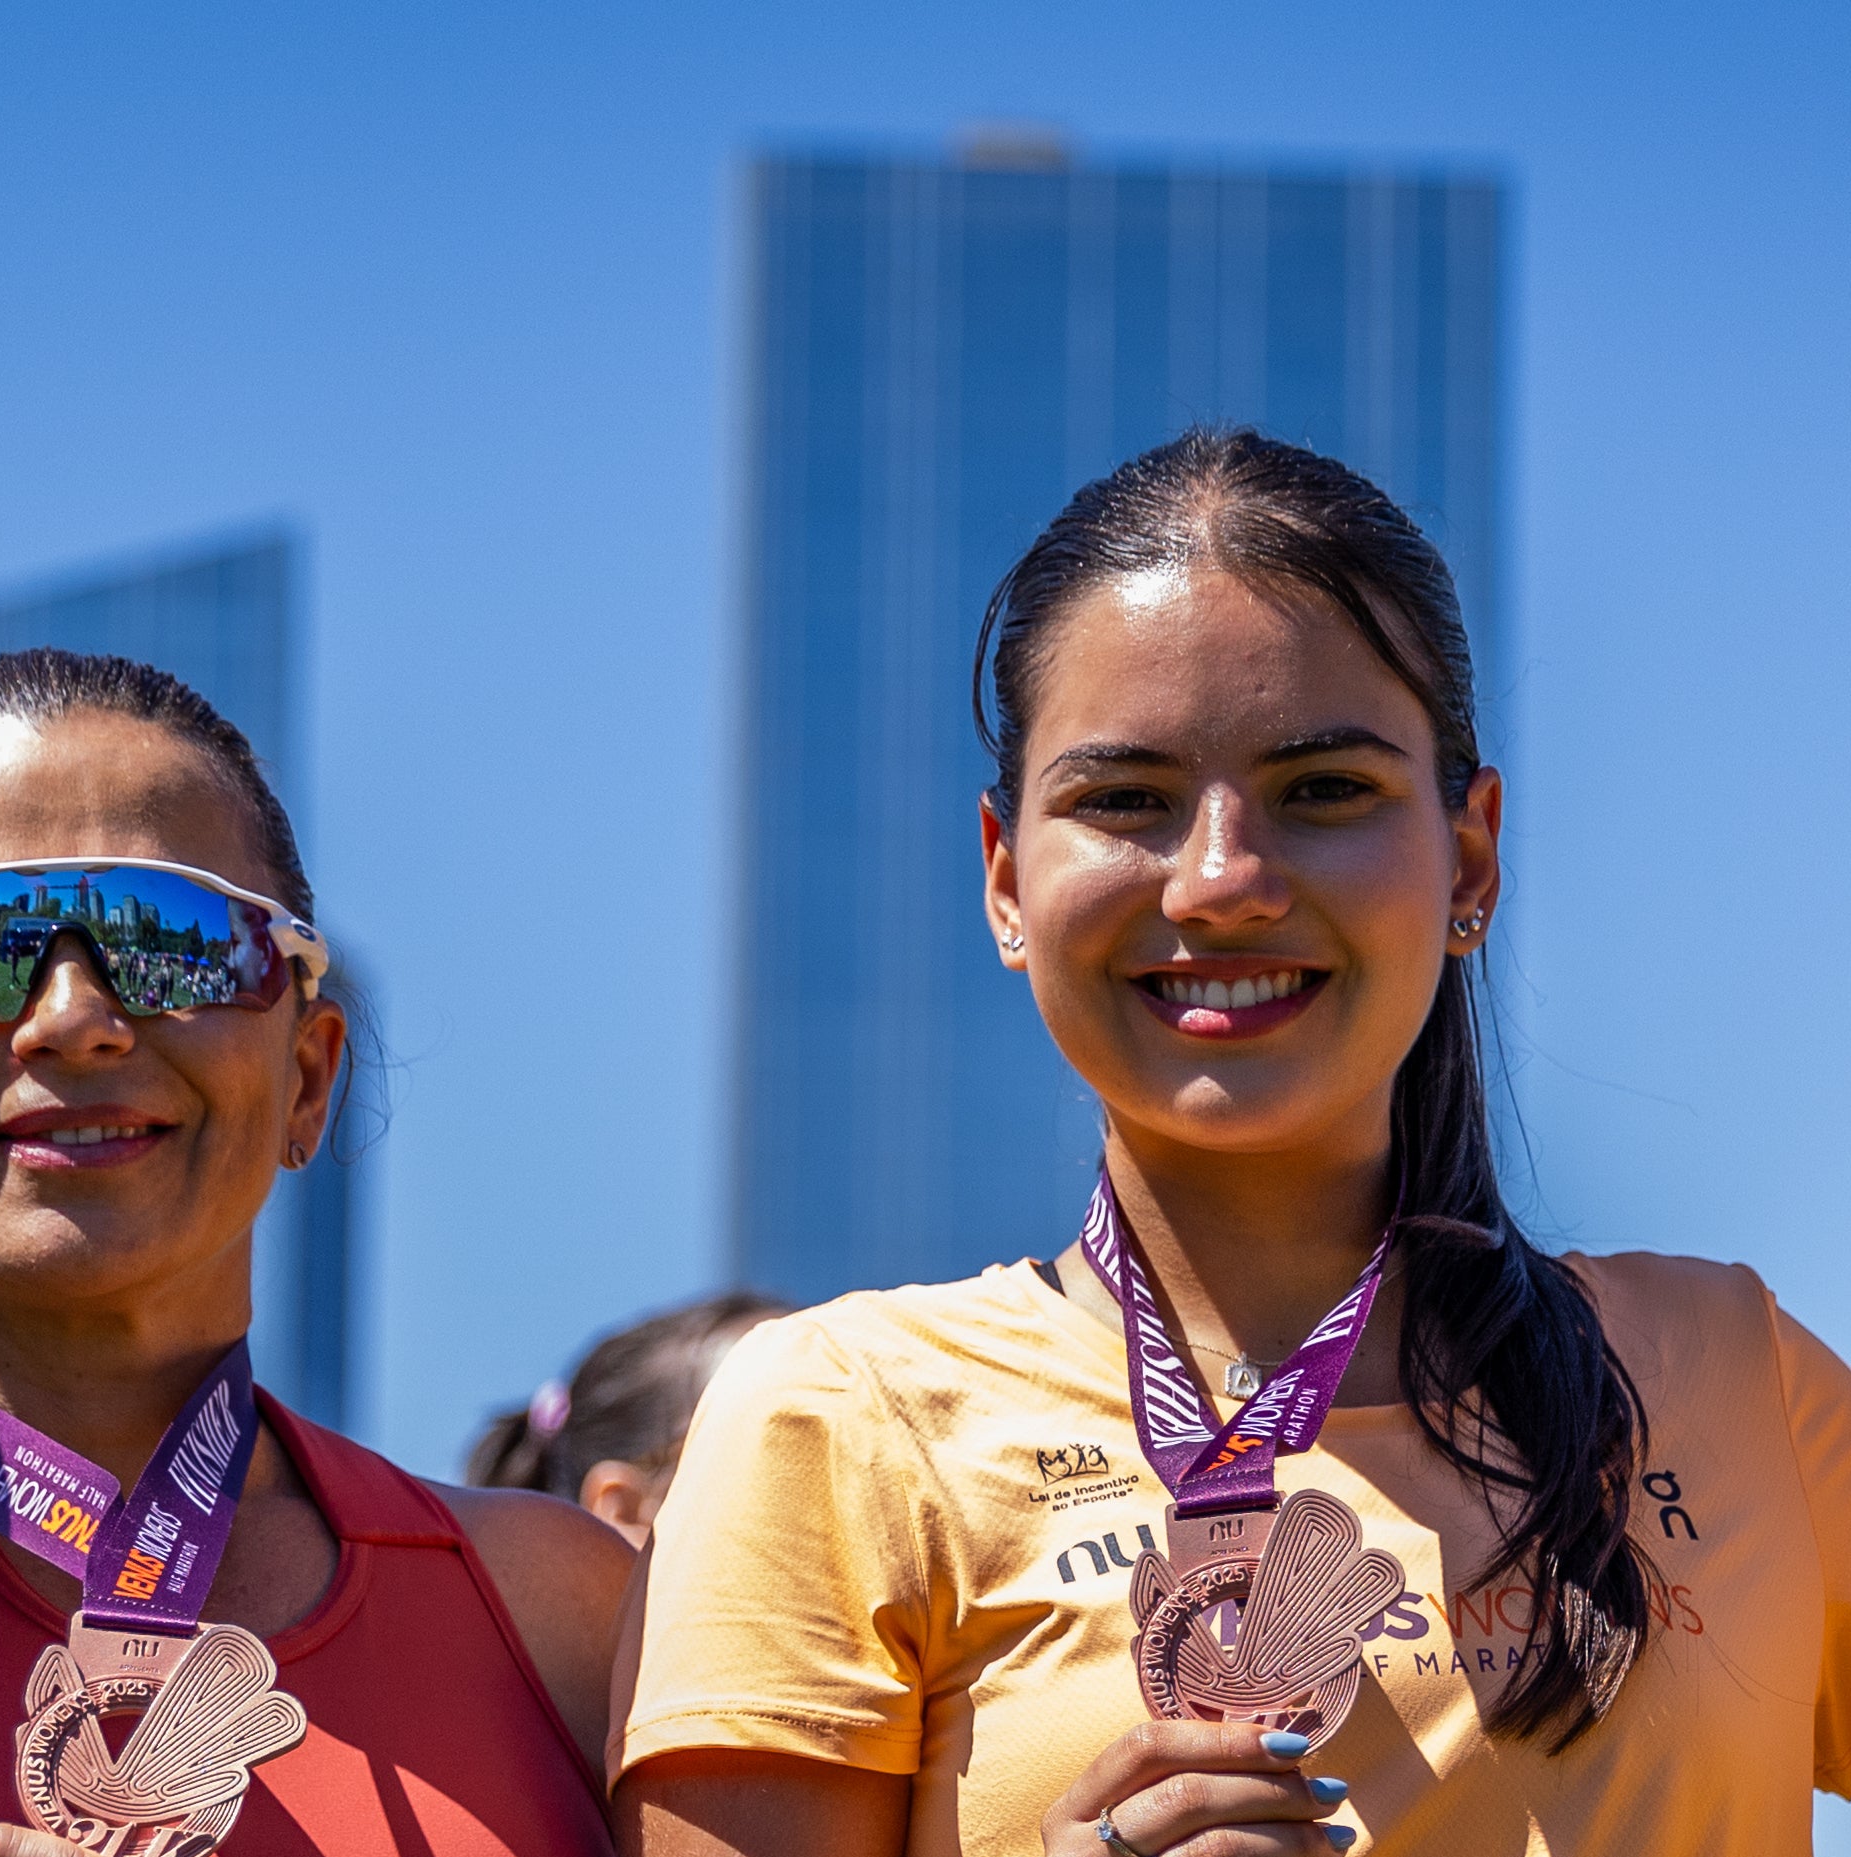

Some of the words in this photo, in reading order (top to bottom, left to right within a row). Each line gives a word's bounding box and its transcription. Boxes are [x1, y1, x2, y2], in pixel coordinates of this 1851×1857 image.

[14, 1445, 76, 1496] MARATHON
[77, 1486, 108, 1511] HALF
[1028, 1492, 1050, 1503] Lei
[1054, 1489, 1071, 1500] de
[1075, 1475, 1139, 1496] Incentivo
[1052, 1503, 1068, 1512] ao
[172, 1540, 200, 1578] MARATHON
[1201, 1567, 1246, 1592] 2025
[105, 1682, 149, 1697] 2025
